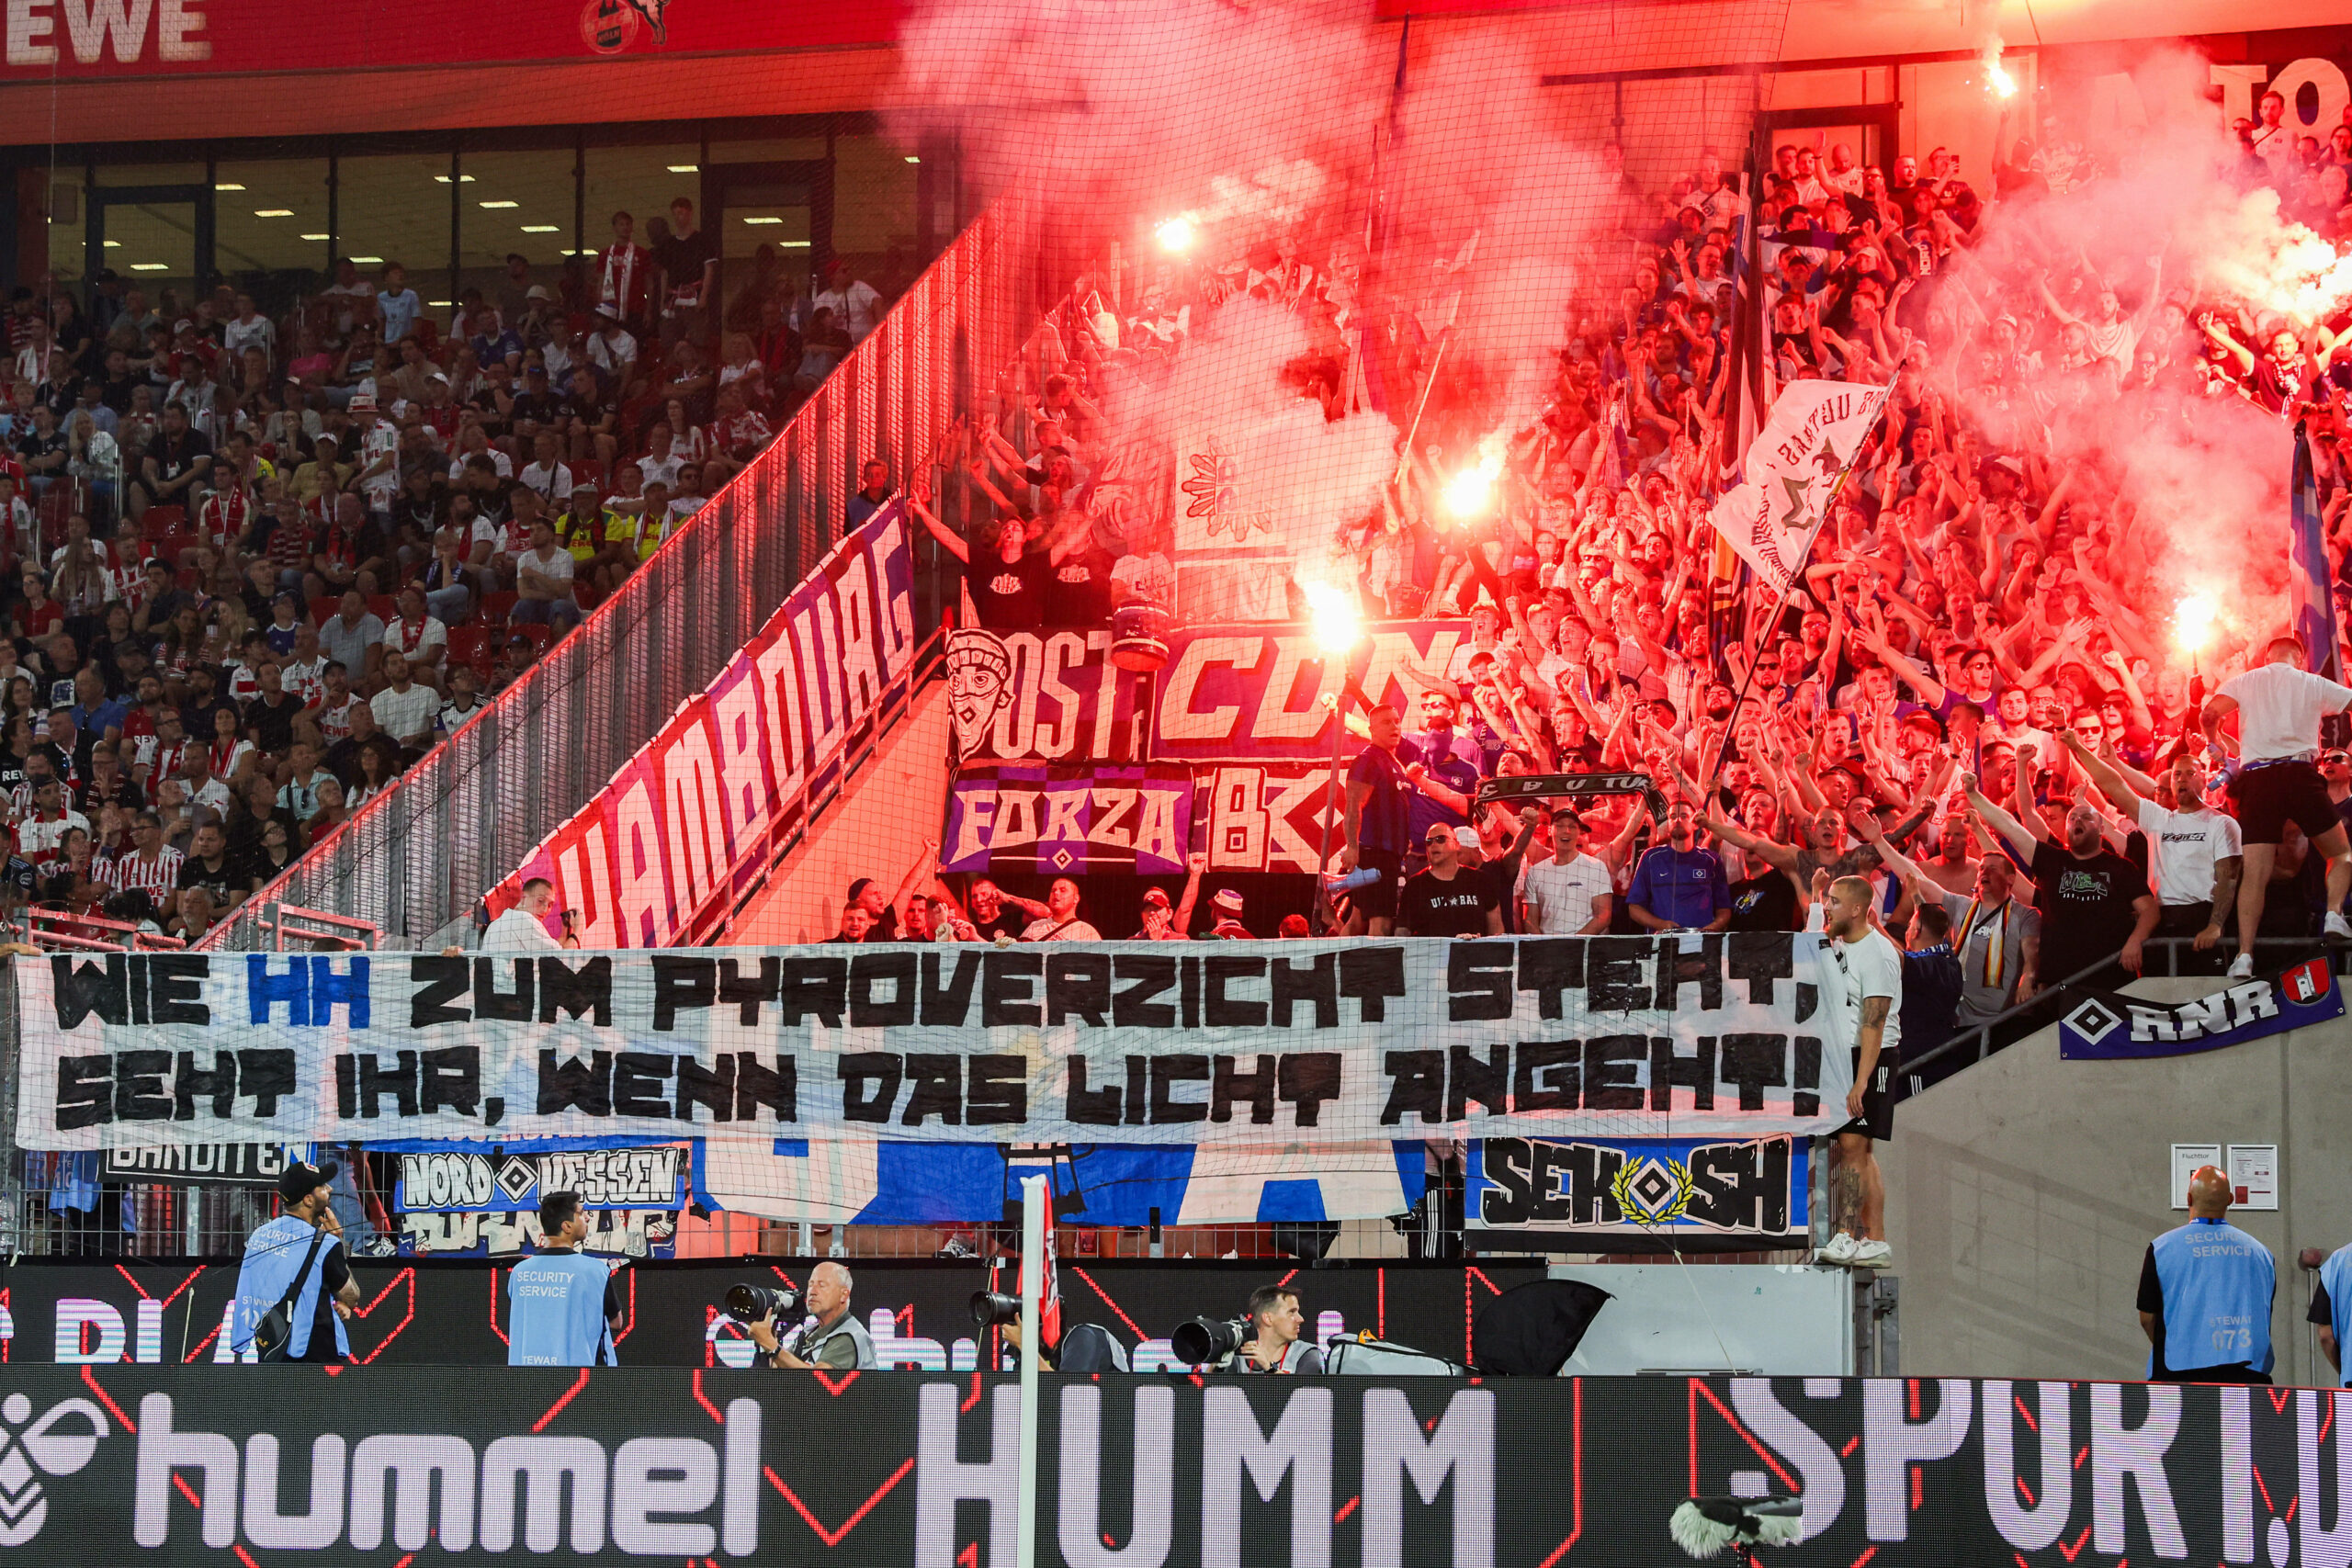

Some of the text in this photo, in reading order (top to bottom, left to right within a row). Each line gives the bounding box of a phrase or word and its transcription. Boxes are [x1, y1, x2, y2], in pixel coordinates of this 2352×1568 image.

[947, 787, 1187, 870] FORZA
[51, 931, 1818, 1031] WIE HH ZUM PYROVERZICHT STEHT,
[56, 1033, 1822, 1131] SEHT IHR, WENN DAS LICHT ANGEHT!
[401, 1152, 494, 1208] NORD
[537, 1147, 681, 1206] HESSEN
[1684, 1132, 1793, 1236] SH
[516, 1270, 575, 1284] SECURITY
[518, 1285, 568, 1298] SERVICE
[134, 1392, 762, 1558] hummel
